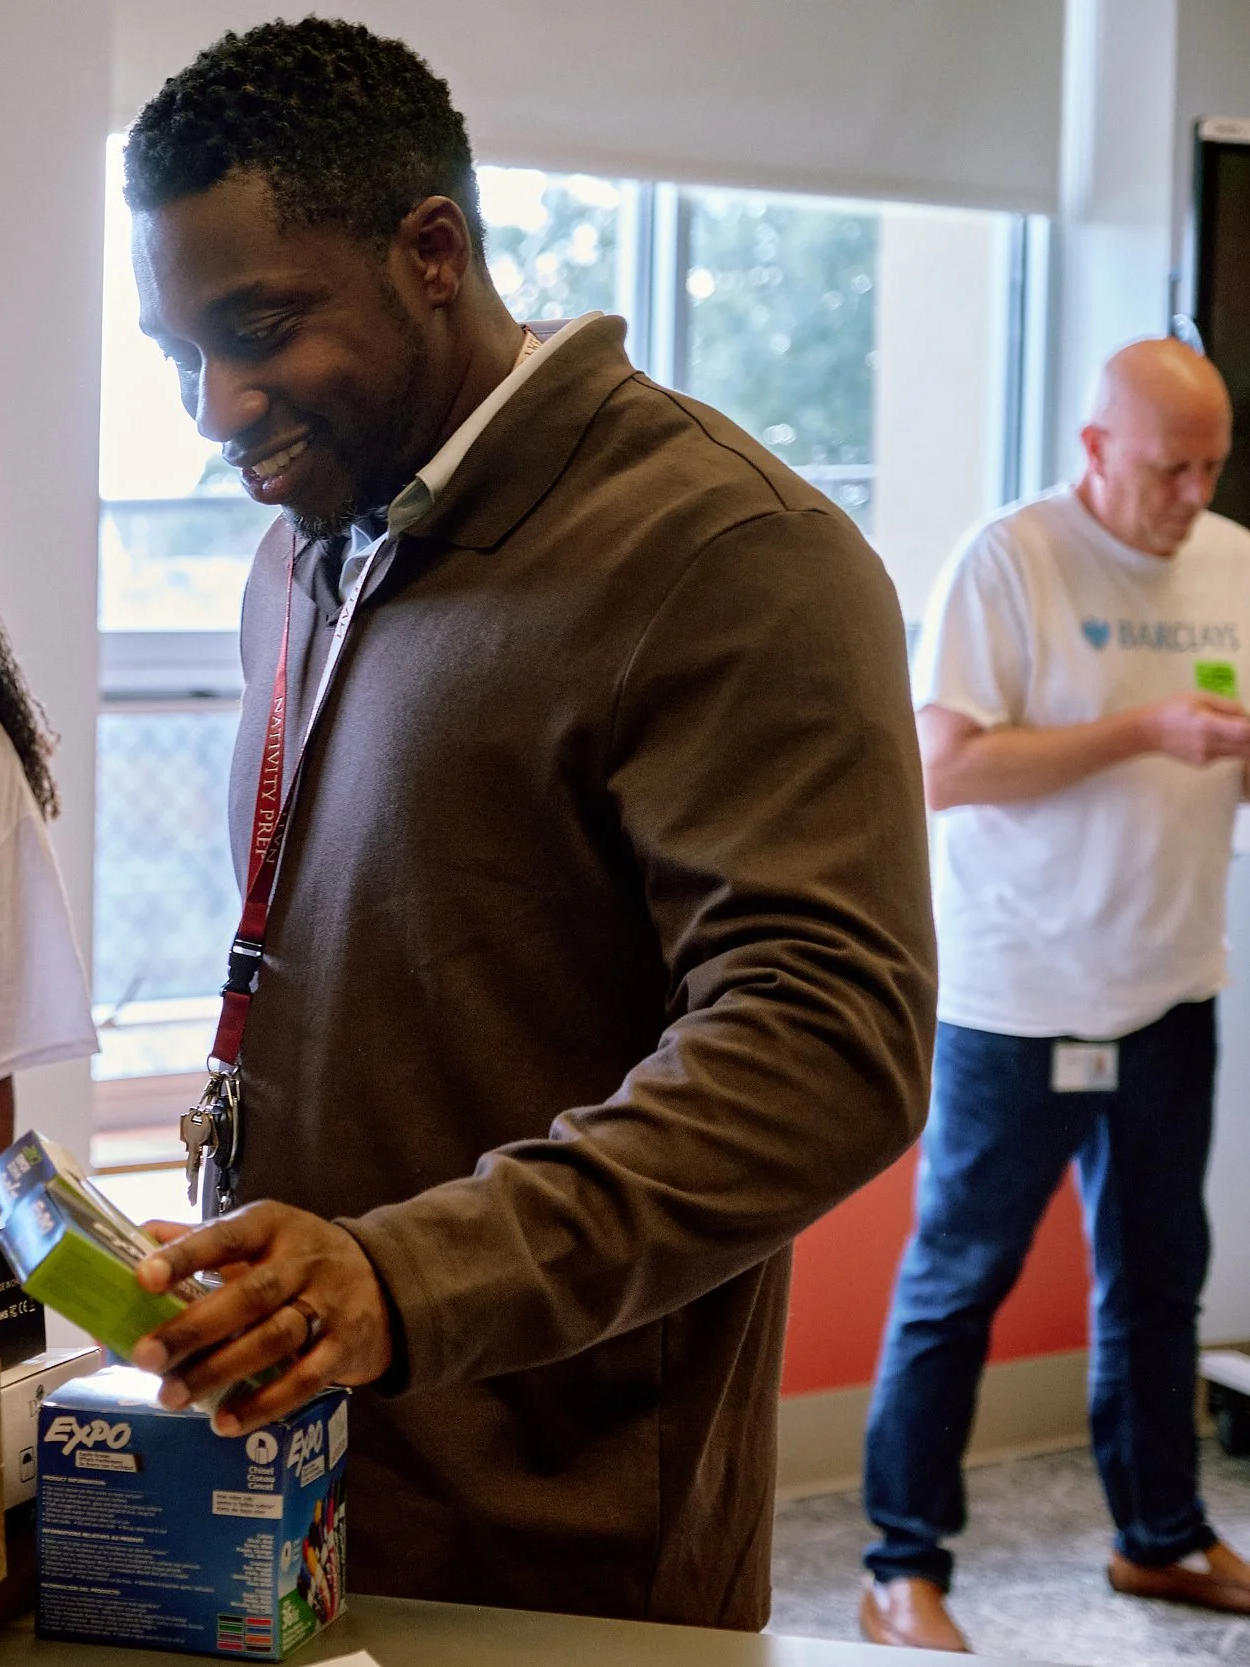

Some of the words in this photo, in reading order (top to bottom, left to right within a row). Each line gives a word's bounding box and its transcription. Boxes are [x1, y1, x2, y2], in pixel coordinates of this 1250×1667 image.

[1117, 618, 1241, 653] BARCLAYS
[262, 697, 284, 801] NATIVITY
[44, 1416, 132, 1455] EXPO
[286, 1419, 323, 1478] EXPO
